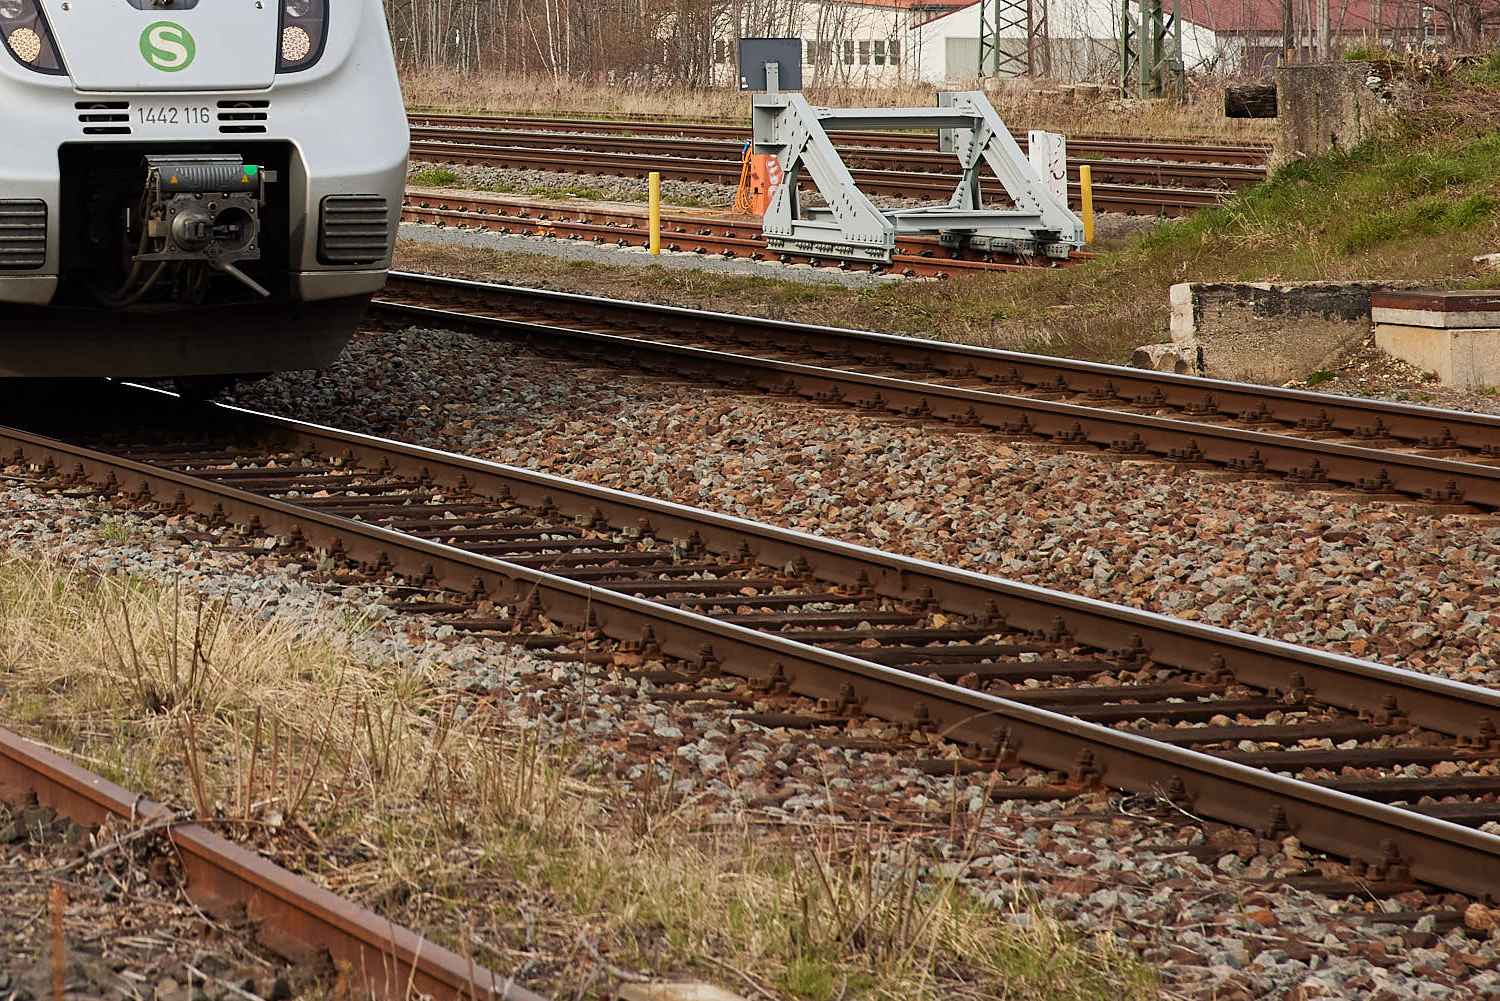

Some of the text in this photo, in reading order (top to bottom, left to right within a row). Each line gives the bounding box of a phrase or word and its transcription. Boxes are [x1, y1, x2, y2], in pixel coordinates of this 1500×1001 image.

[147, 25, 189, 69] S
[138, 107, 210, 124] 1442 116
